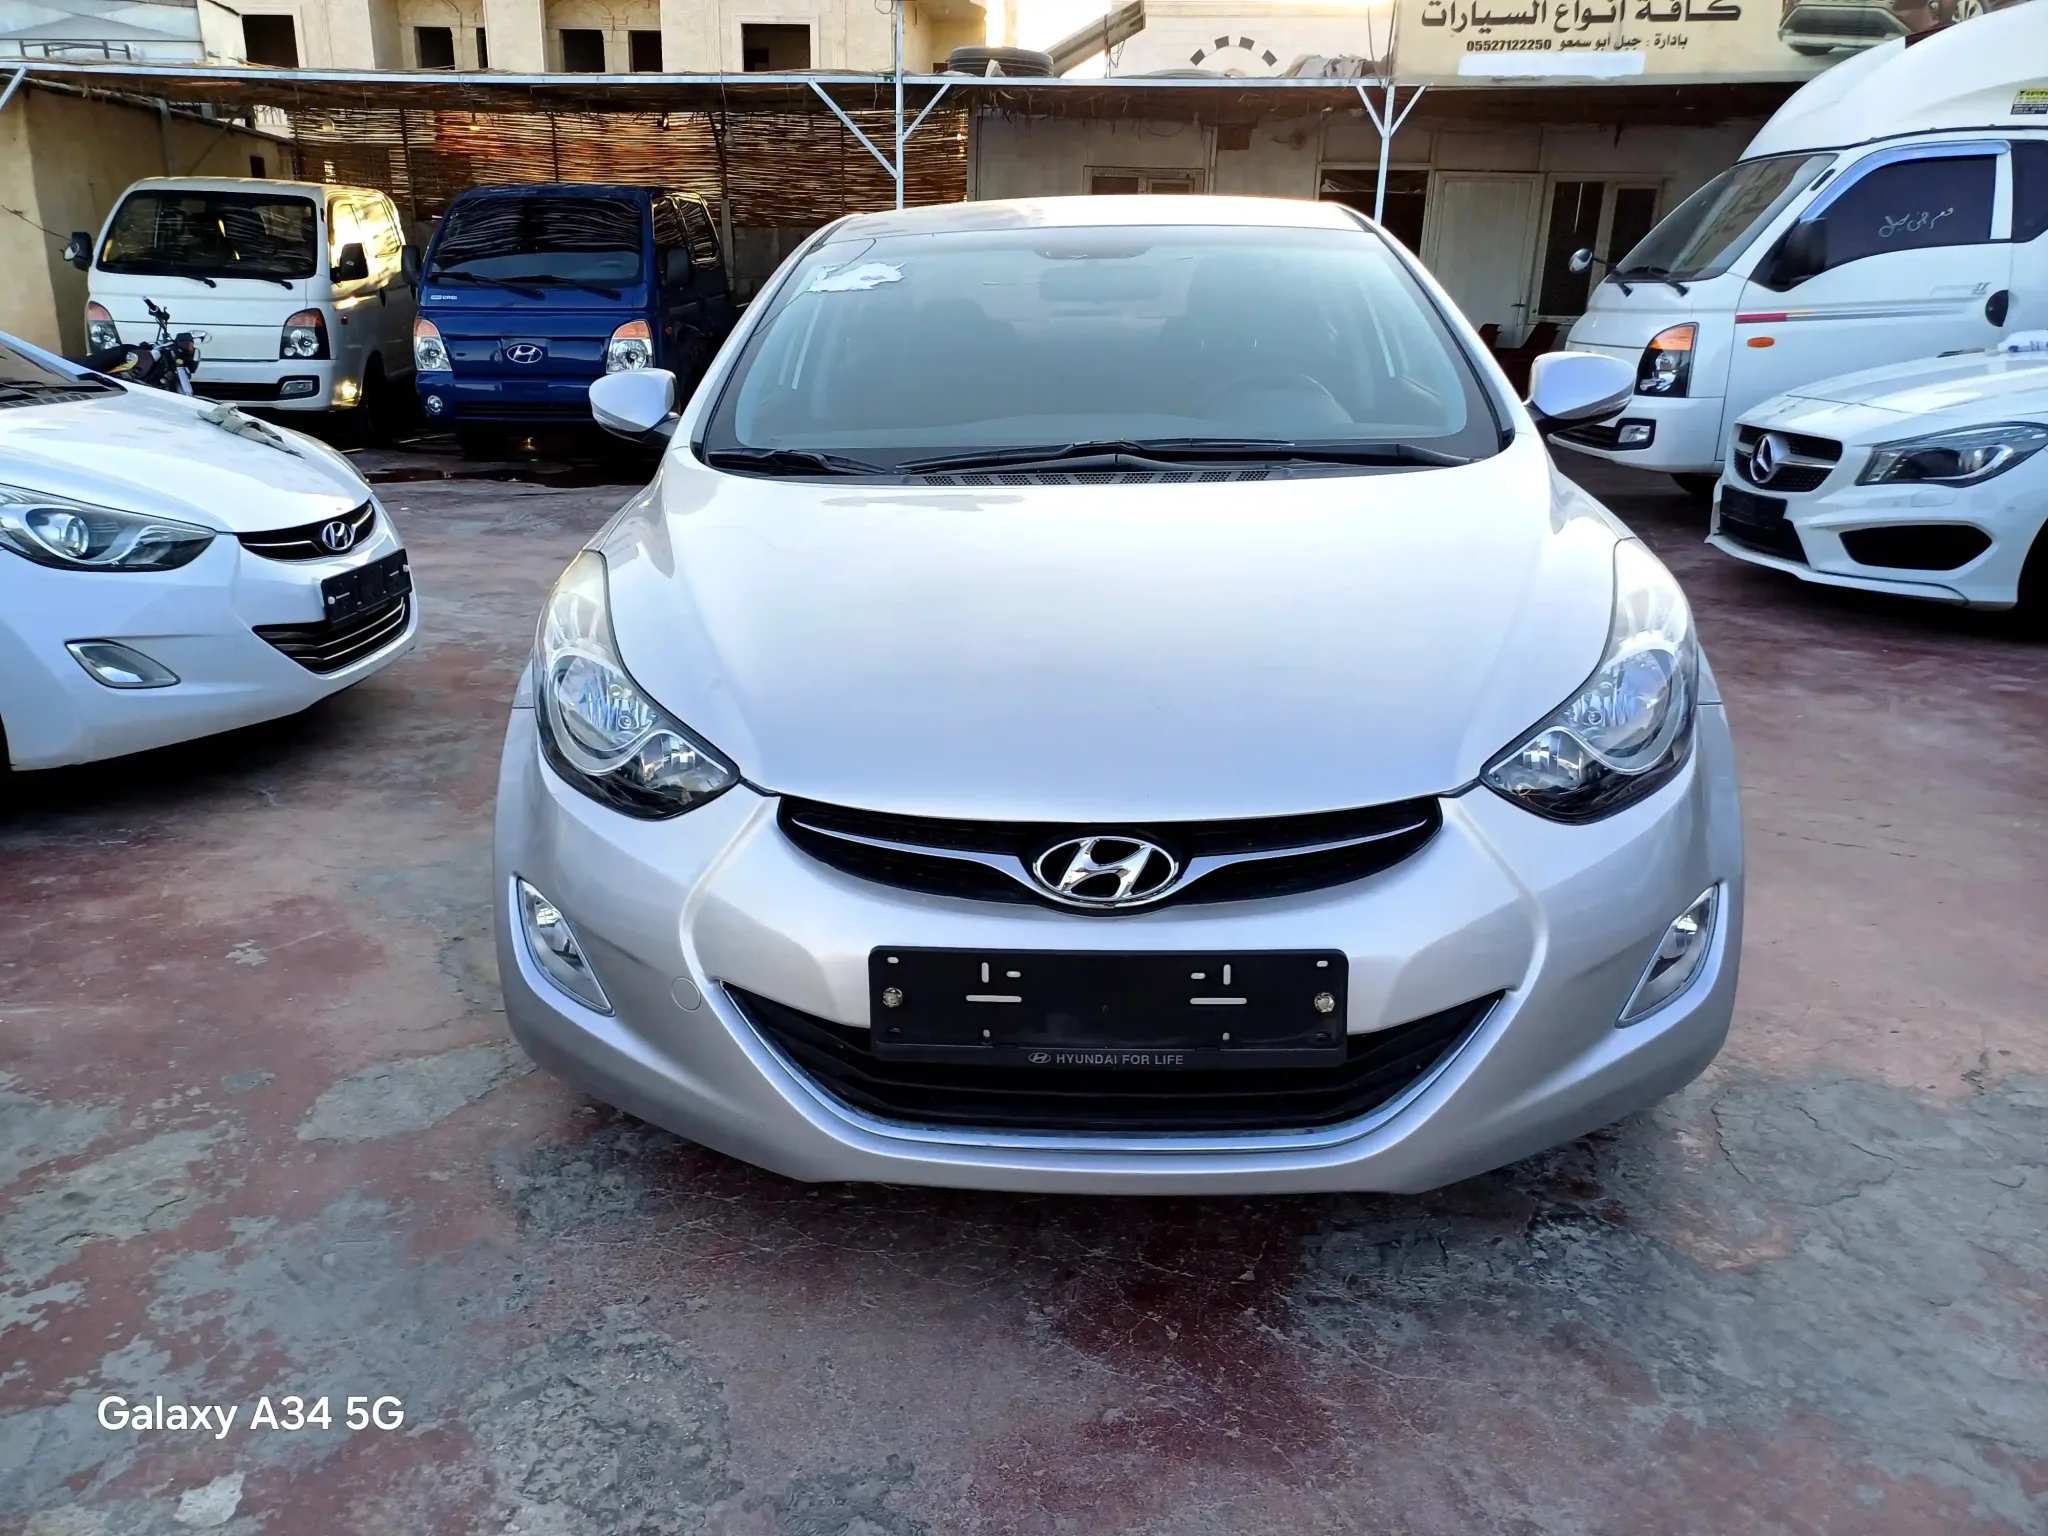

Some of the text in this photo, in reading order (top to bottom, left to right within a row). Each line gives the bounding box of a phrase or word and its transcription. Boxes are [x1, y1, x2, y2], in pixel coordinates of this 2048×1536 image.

[1056, 1053, 1184, 1065] HYUNDAI FOR LIFE
